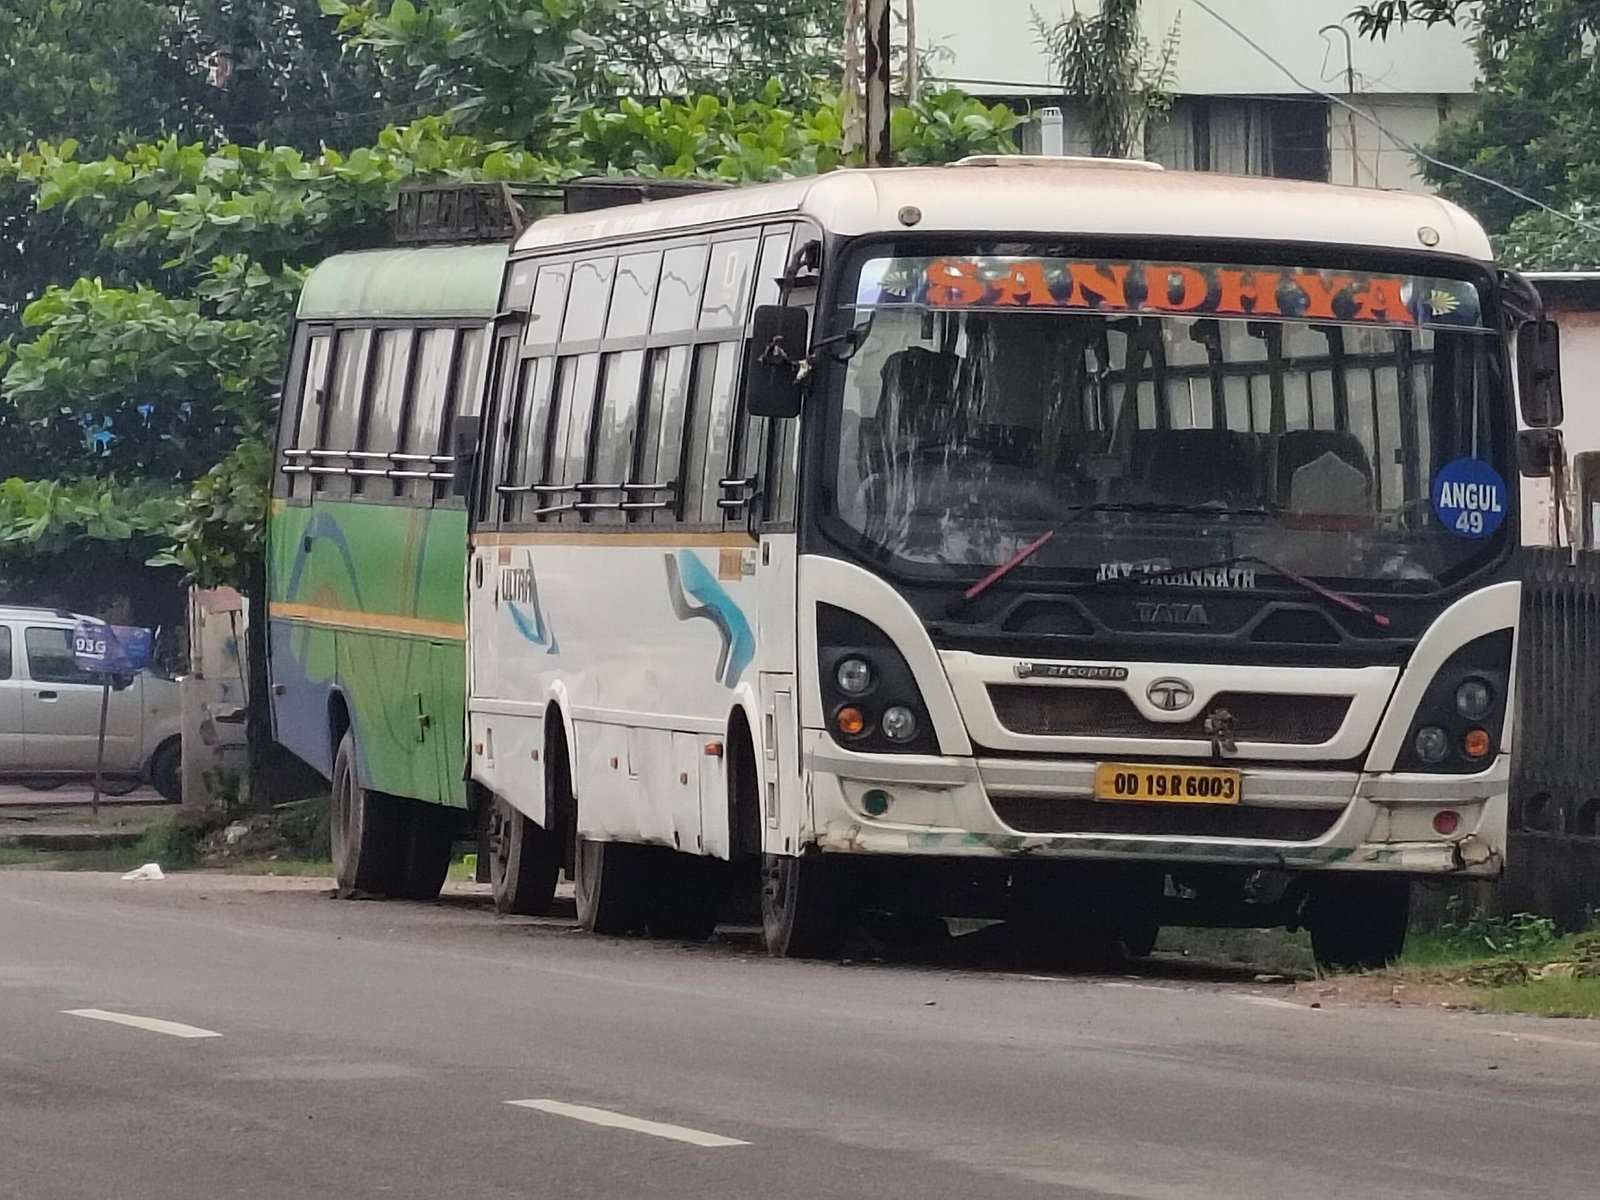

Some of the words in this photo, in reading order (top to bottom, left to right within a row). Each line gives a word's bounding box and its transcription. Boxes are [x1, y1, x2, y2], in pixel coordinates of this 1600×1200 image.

[924, 256, 1415, 325] SANDHYA
[1440, 481, 1502, 512] ANGUL
[1455, 510, 1483, 533] 49
[1136, 602, 1209, 624] TATA
